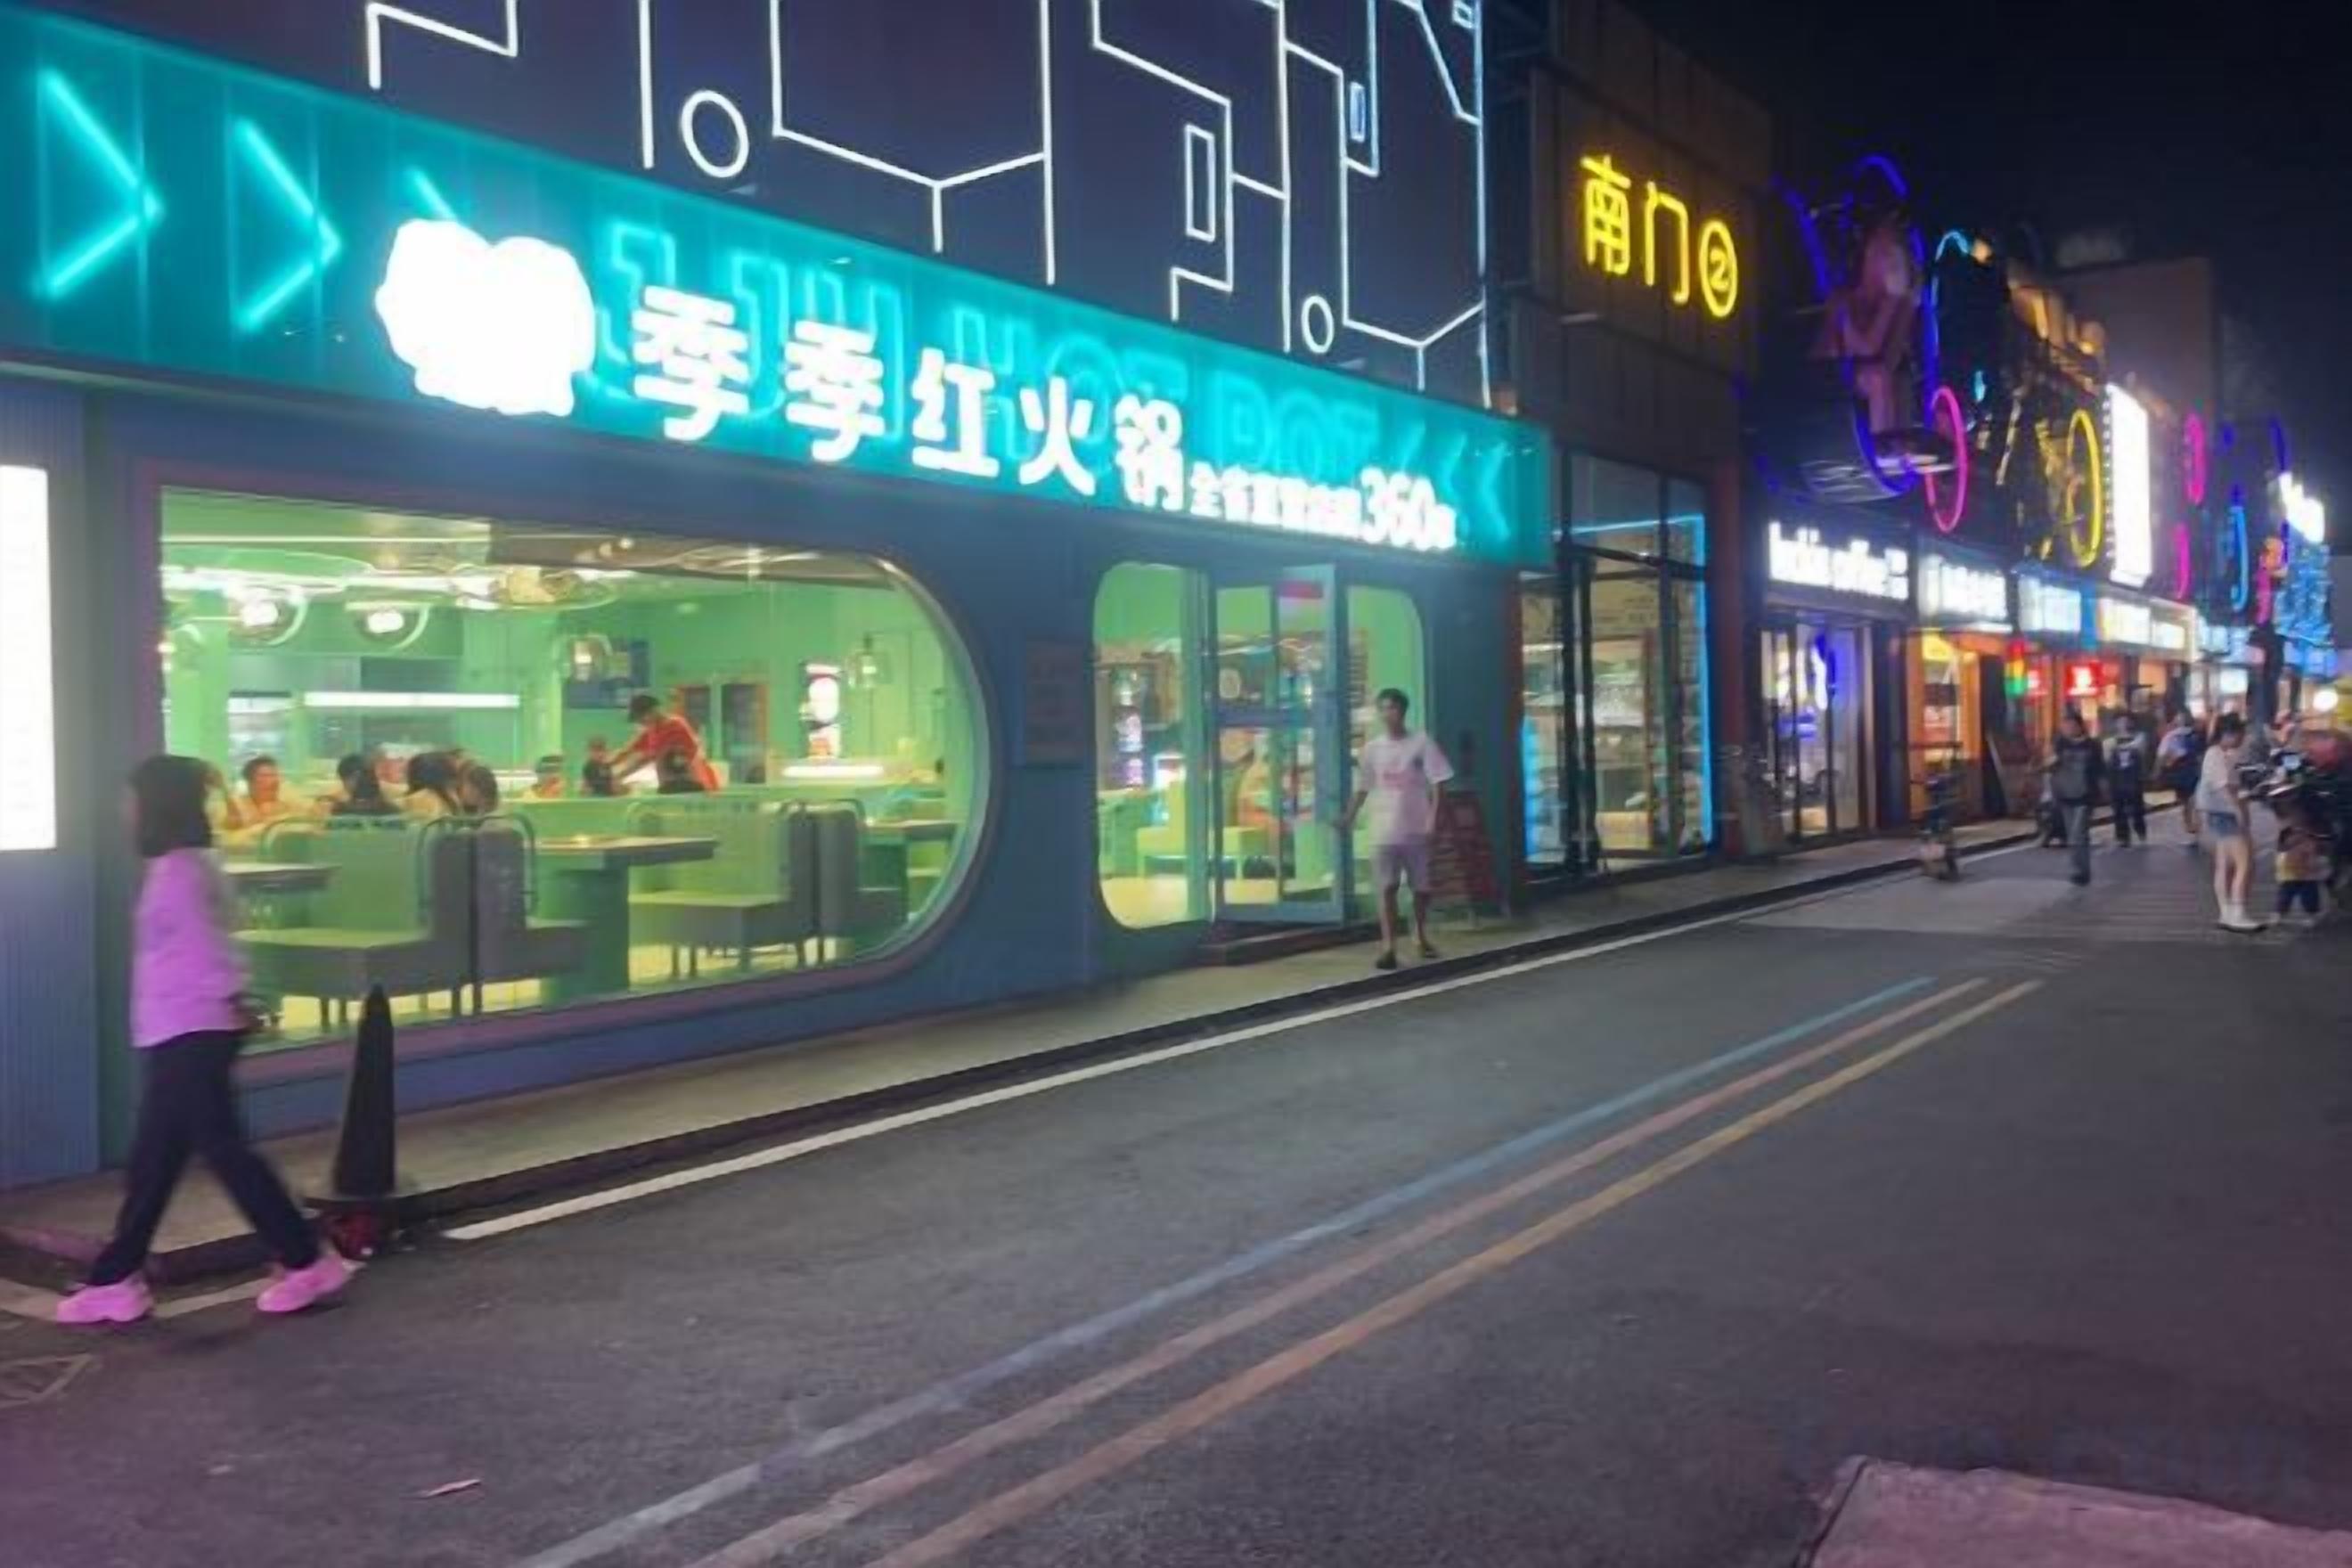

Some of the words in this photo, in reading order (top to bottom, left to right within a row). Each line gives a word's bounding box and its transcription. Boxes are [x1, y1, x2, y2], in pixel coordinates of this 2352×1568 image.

[631, 284, 1183, 511] 季季红火锅
